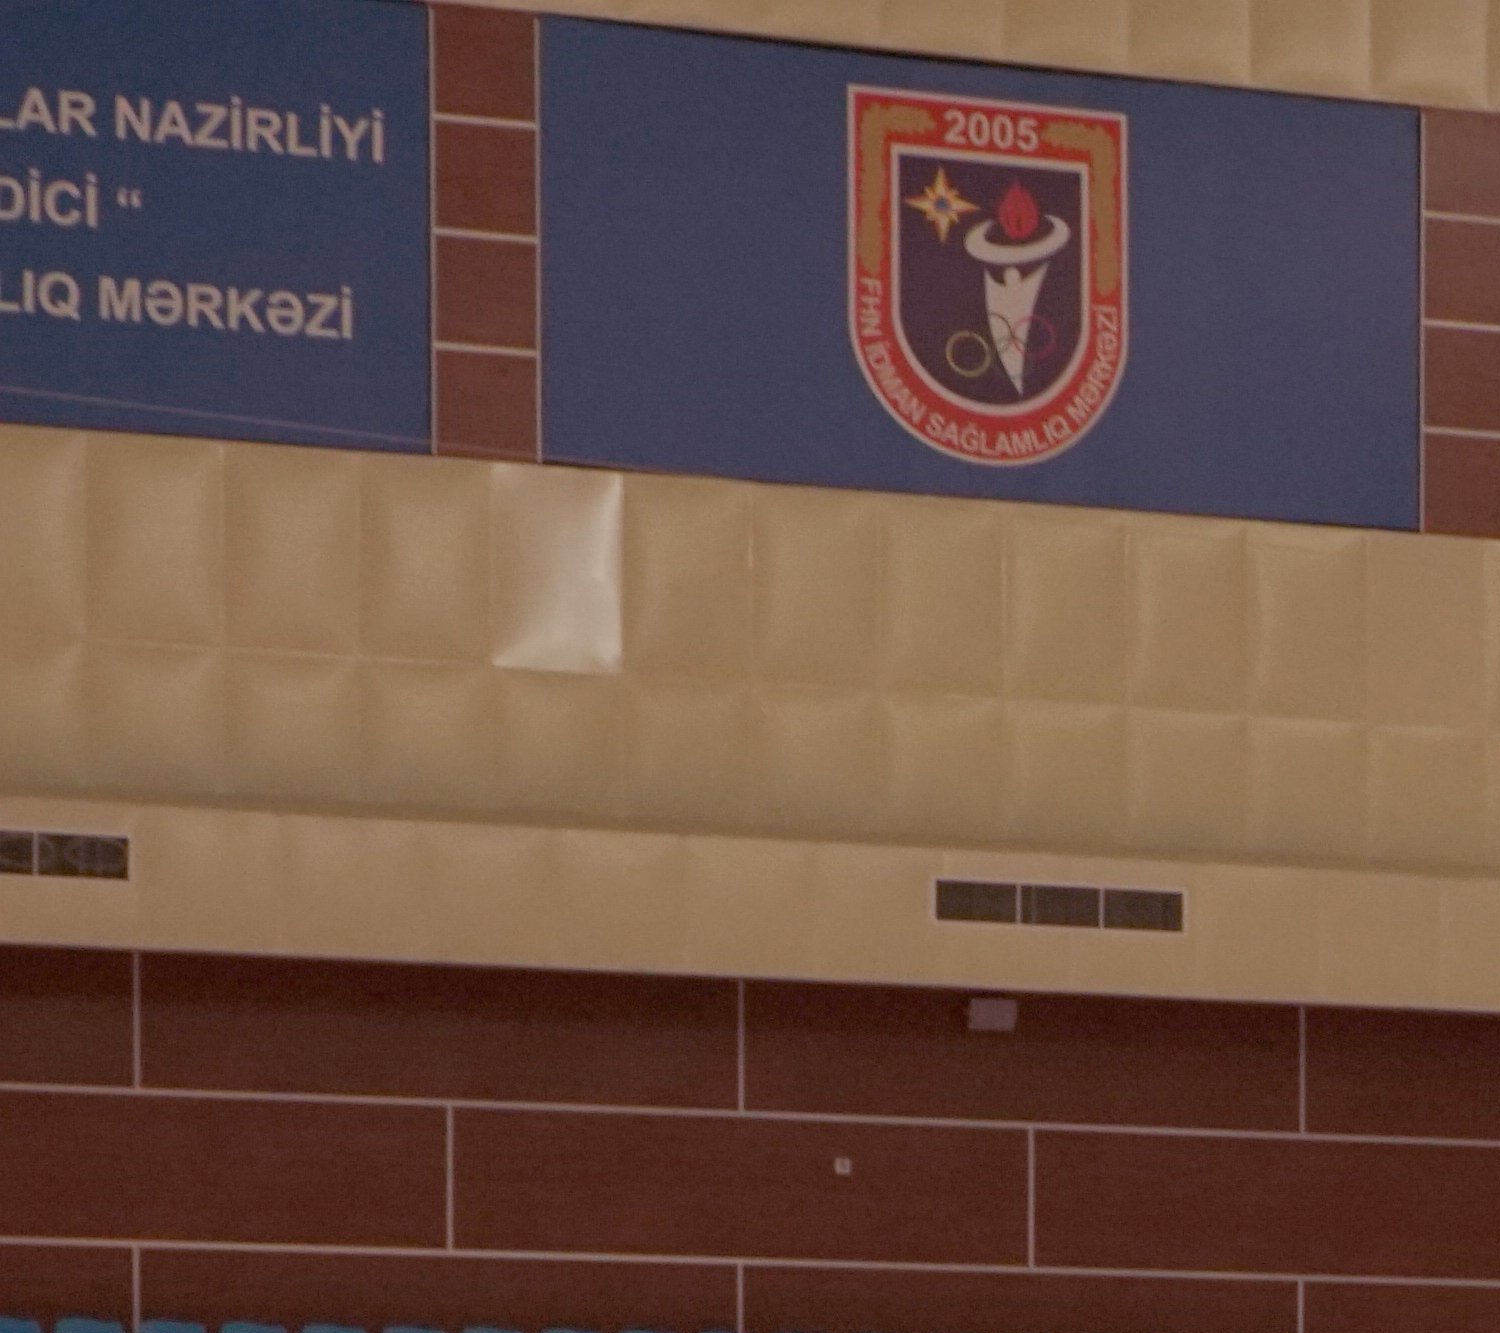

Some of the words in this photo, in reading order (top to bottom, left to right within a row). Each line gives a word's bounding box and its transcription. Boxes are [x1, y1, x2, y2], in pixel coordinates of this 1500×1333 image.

[0, 86, 97, 137] AR
[115, 93, 384, 163] NAZİRLİYİ
[944, 110, 1040, 153] 2005
[0, 270, 80, 321] IQ
[99, 275, 353, 340] MƏRKƏZİ
[859, 278, 883, 337] FHN
[925, 414, 1075, 456] SAĞLAMLIQ
